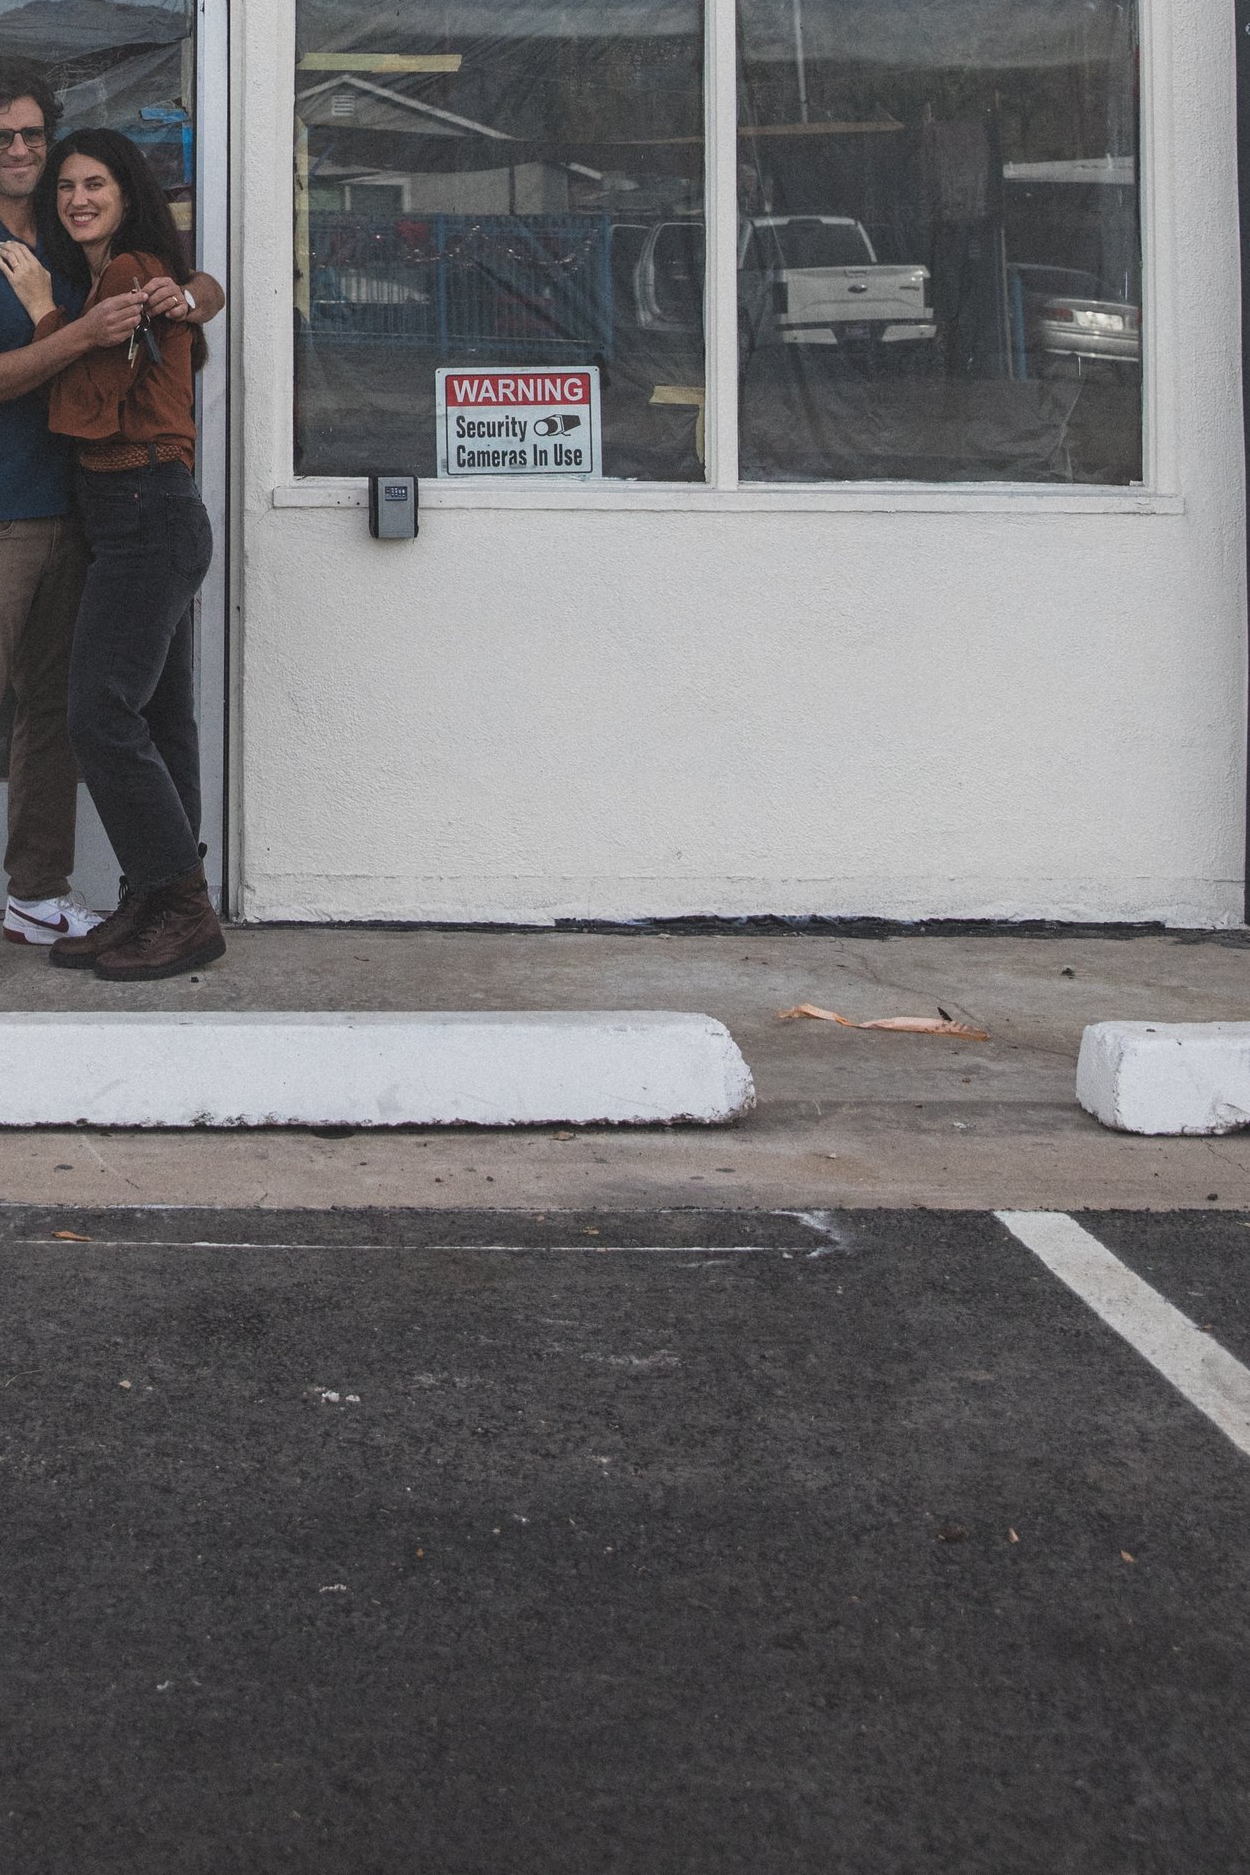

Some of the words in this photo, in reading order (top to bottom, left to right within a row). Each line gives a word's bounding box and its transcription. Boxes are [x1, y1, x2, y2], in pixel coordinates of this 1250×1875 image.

[453, 378, 583, 403] WARNING
[456, 415, 527, 442] Security
[457, 445, 527, 467] Cameras
[533, 444, 548, 466] In
[554, 444, 583, 466] Use
